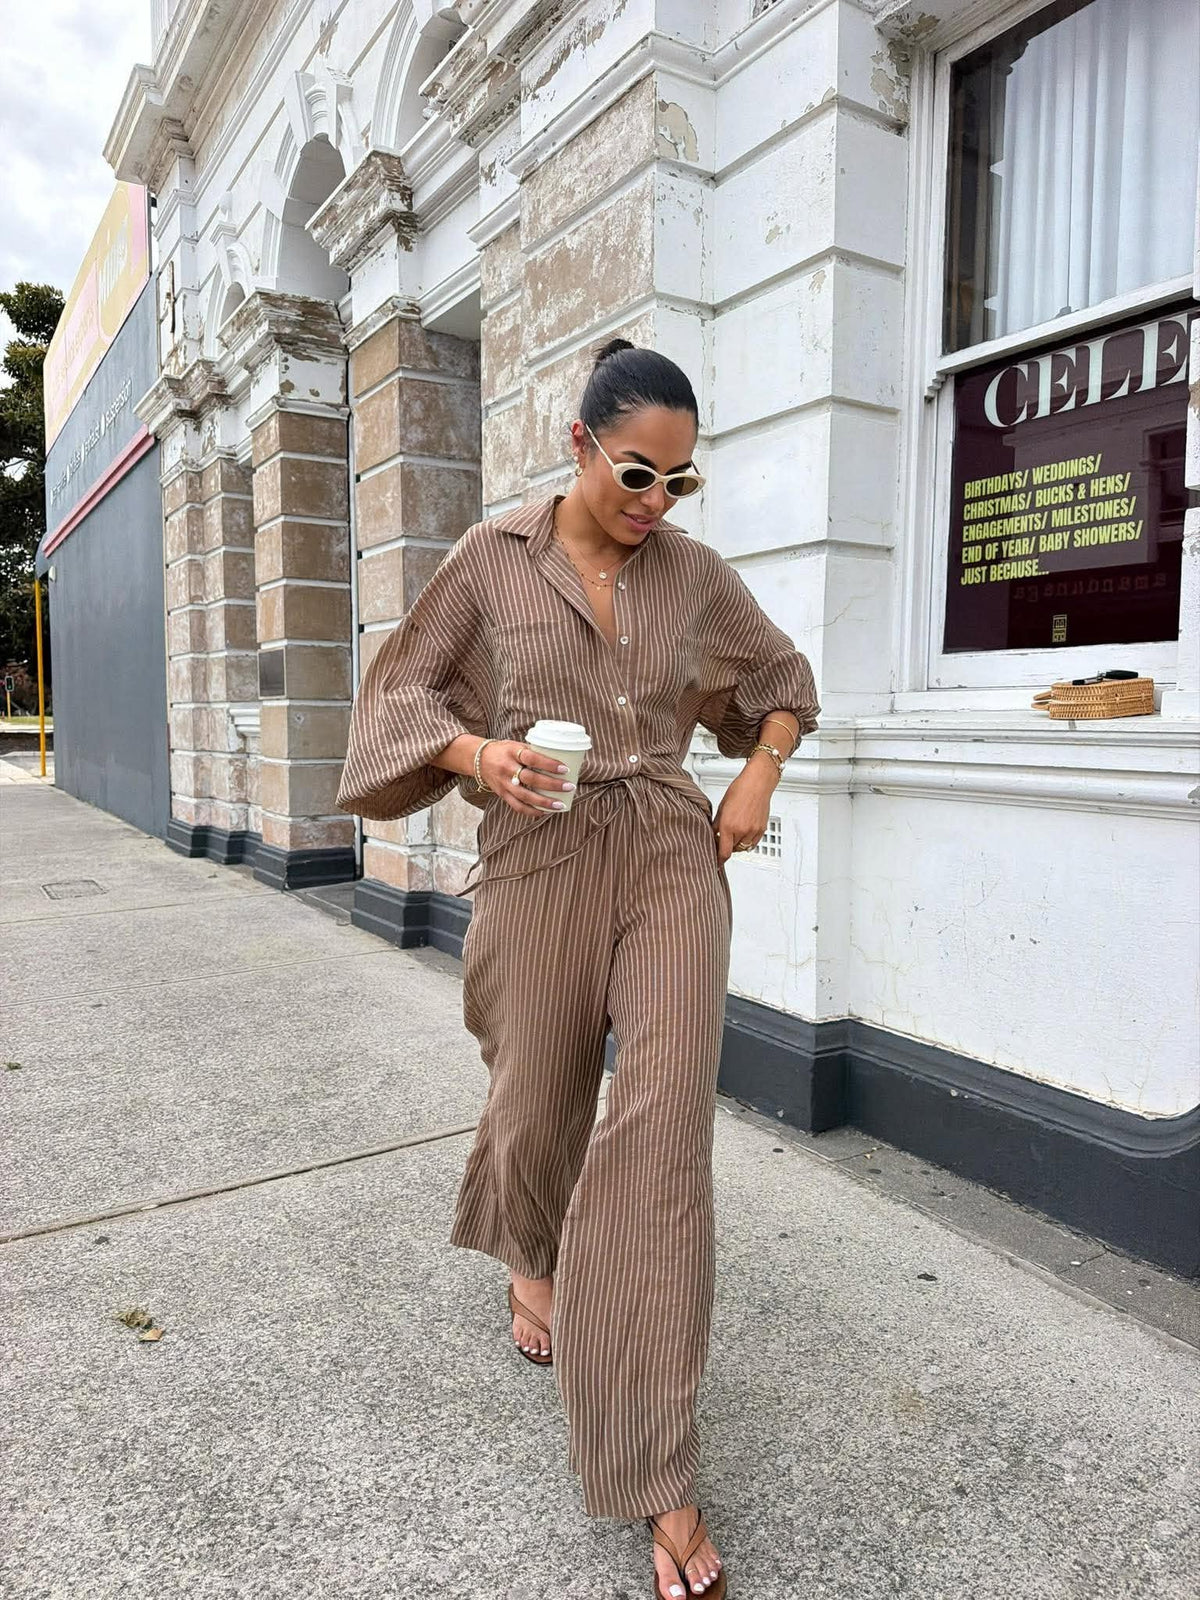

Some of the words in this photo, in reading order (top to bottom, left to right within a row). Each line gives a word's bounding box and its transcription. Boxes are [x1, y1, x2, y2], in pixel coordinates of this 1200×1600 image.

[963, 491, 1032, 521] CHRISTMAS/
[1035, 483, 1075, 508] BUCKS
[1077, 483, 1086, 500] &
[1089, 472, 1131, 498] HENS/
[964, 469, 1029, 499] BIRTHDAYS/
[1032, 453, 1102, 485] WEDDINGS/
[961, 545, 983, 564] END
[985, 542, 999, 561] OF
[1001, 536, 1036, 559] YEAR/
[1039, 531, 1071, 553] BABY
[1073, 519, 1143, 547] SHOWERS/
[962, 511, 1048, 543] ENGAGEMENTS/
[1051, 496, 1136, 528] MILESTONES/
[961, 566, 988, 586] JUST
[989, 559, 1050, 583] BECAUSE...
